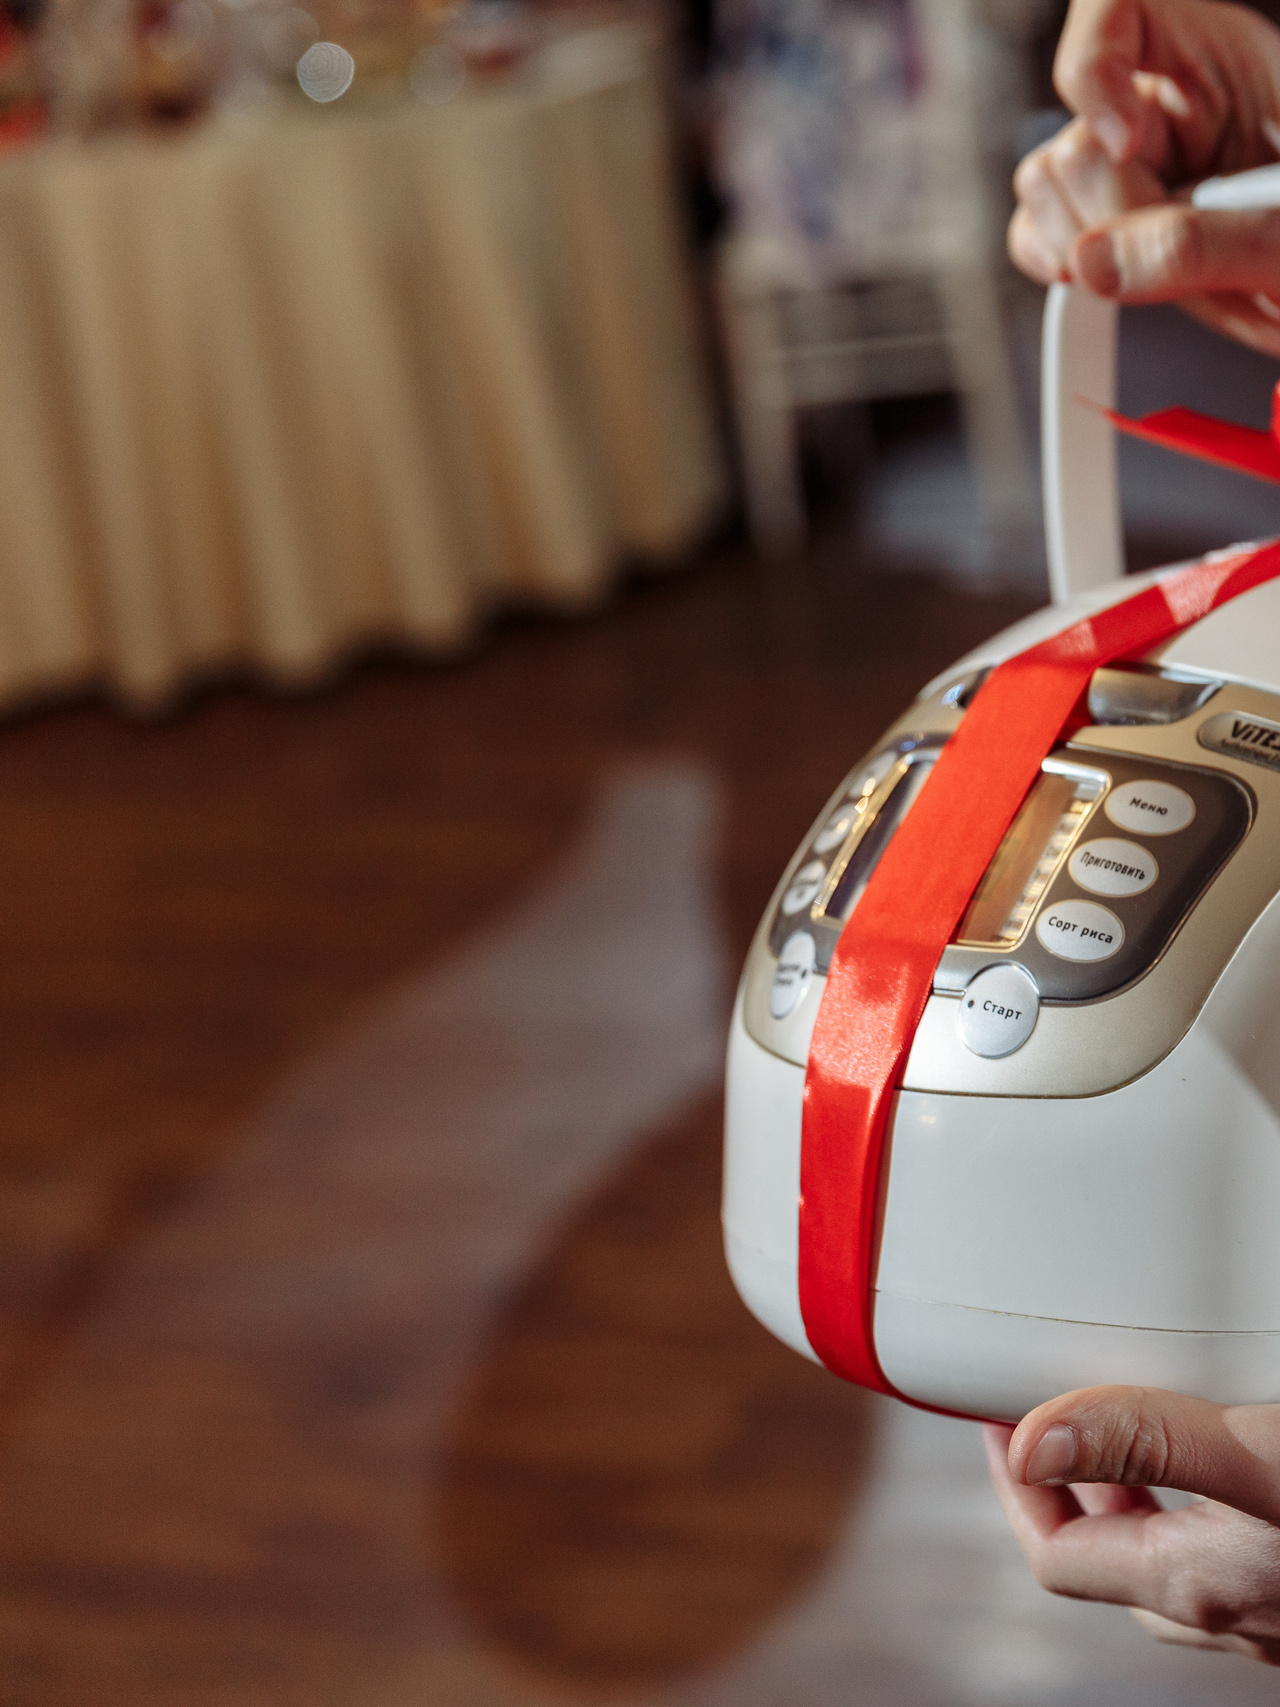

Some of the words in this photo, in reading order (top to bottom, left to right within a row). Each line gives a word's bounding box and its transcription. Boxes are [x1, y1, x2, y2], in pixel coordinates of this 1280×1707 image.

[1129, 797, 1168, 815] Меню
[1080, 851, 1146, 881] Приготовить
[1048, 916, 1078, 932] Сорт
[1080, 927, 1113, 944] риса
[983, 1000, 1022, 1020] Старт
